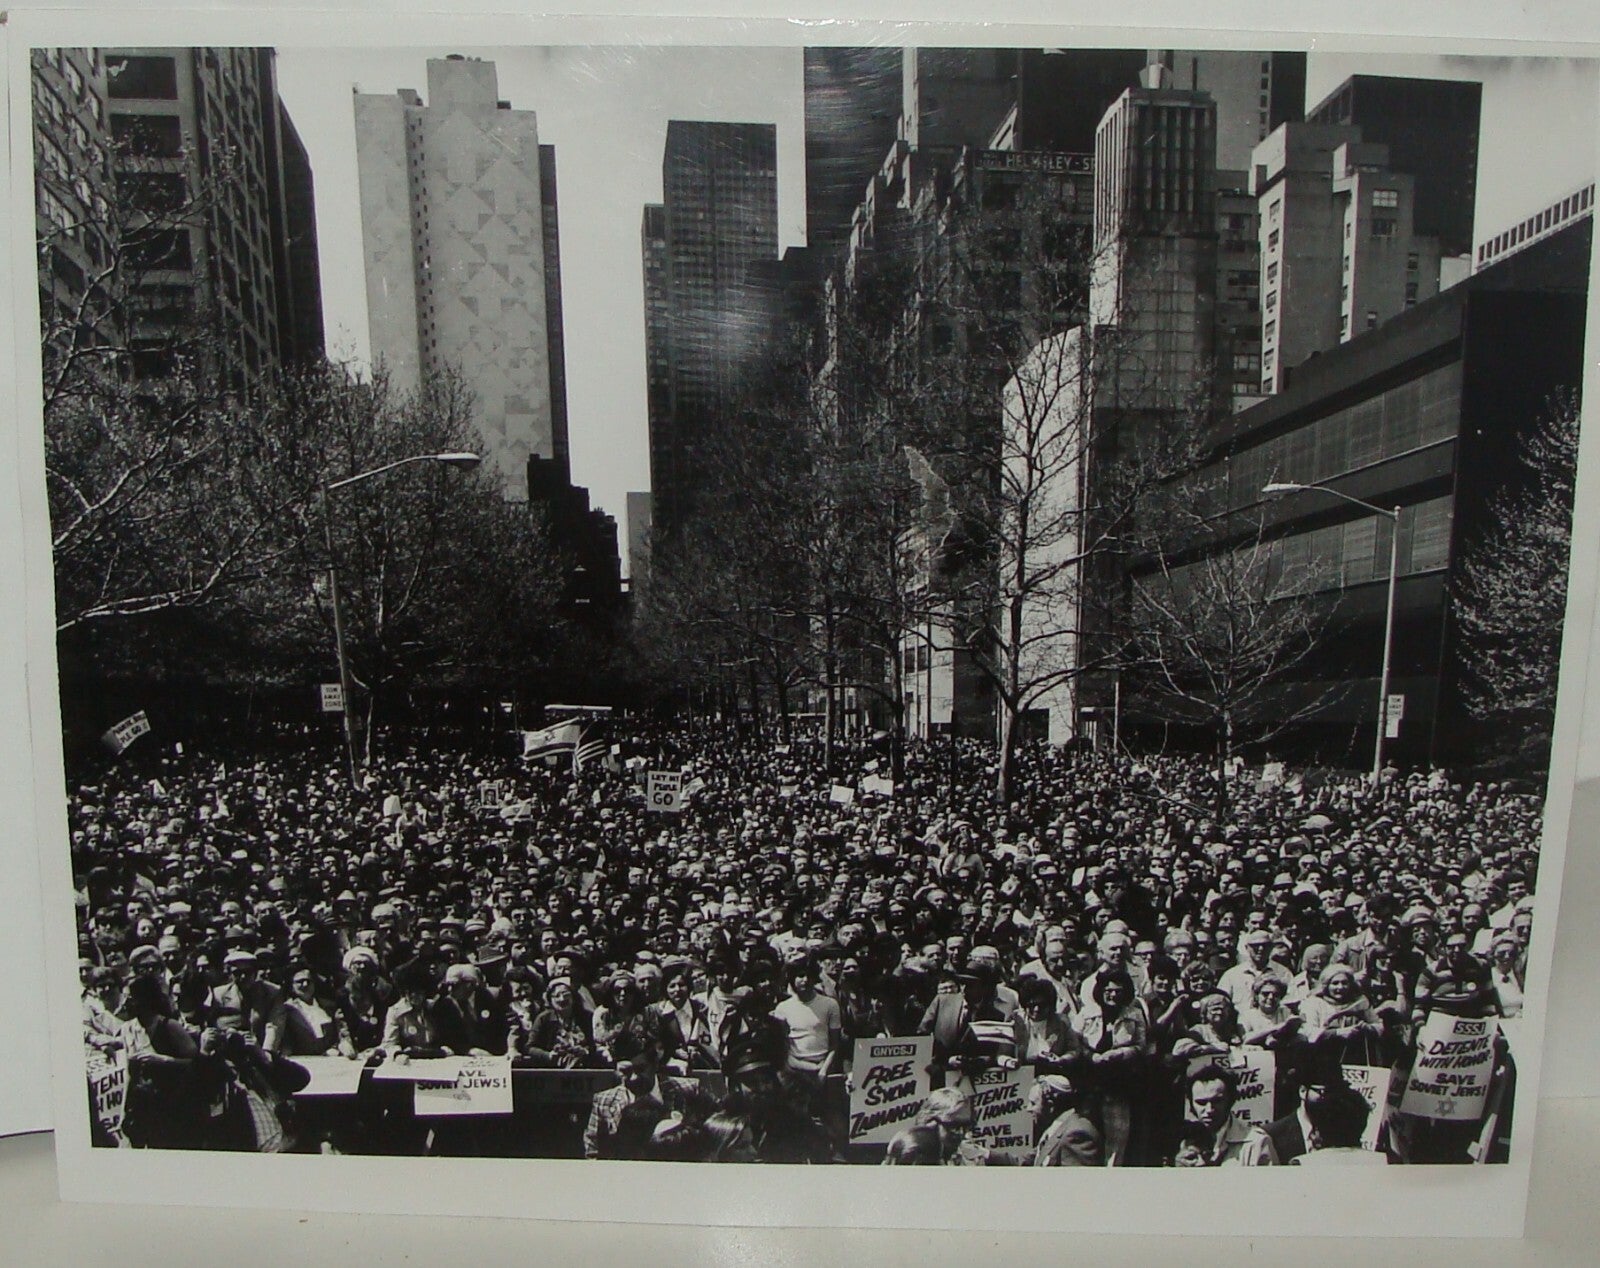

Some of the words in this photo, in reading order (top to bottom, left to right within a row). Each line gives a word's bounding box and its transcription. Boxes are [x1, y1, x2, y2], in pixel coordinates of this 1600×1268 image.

[654, 782, 677, 791] PEOPLE
[653, 792, 673, 805] GO
[1429, 1034, 1491, 1055] DETENTE
[1419, 1056, 1455, 1069] WITH
[861, 1060, 914, 1089] FREE
[1435, 1073, 1476, 1085] SAVE
[463, 1078, 507, 1089] JEWS!
[1410, 1079, 1449, 1096] SOVIET
[1450, 1084, 1487, 1097] JEWS!
[865, 1080, 917, 1106] SYLVA
[972, 1124, 1012, 1138] SAVE
[990, 1135, 1029, 1148] JEWS!
